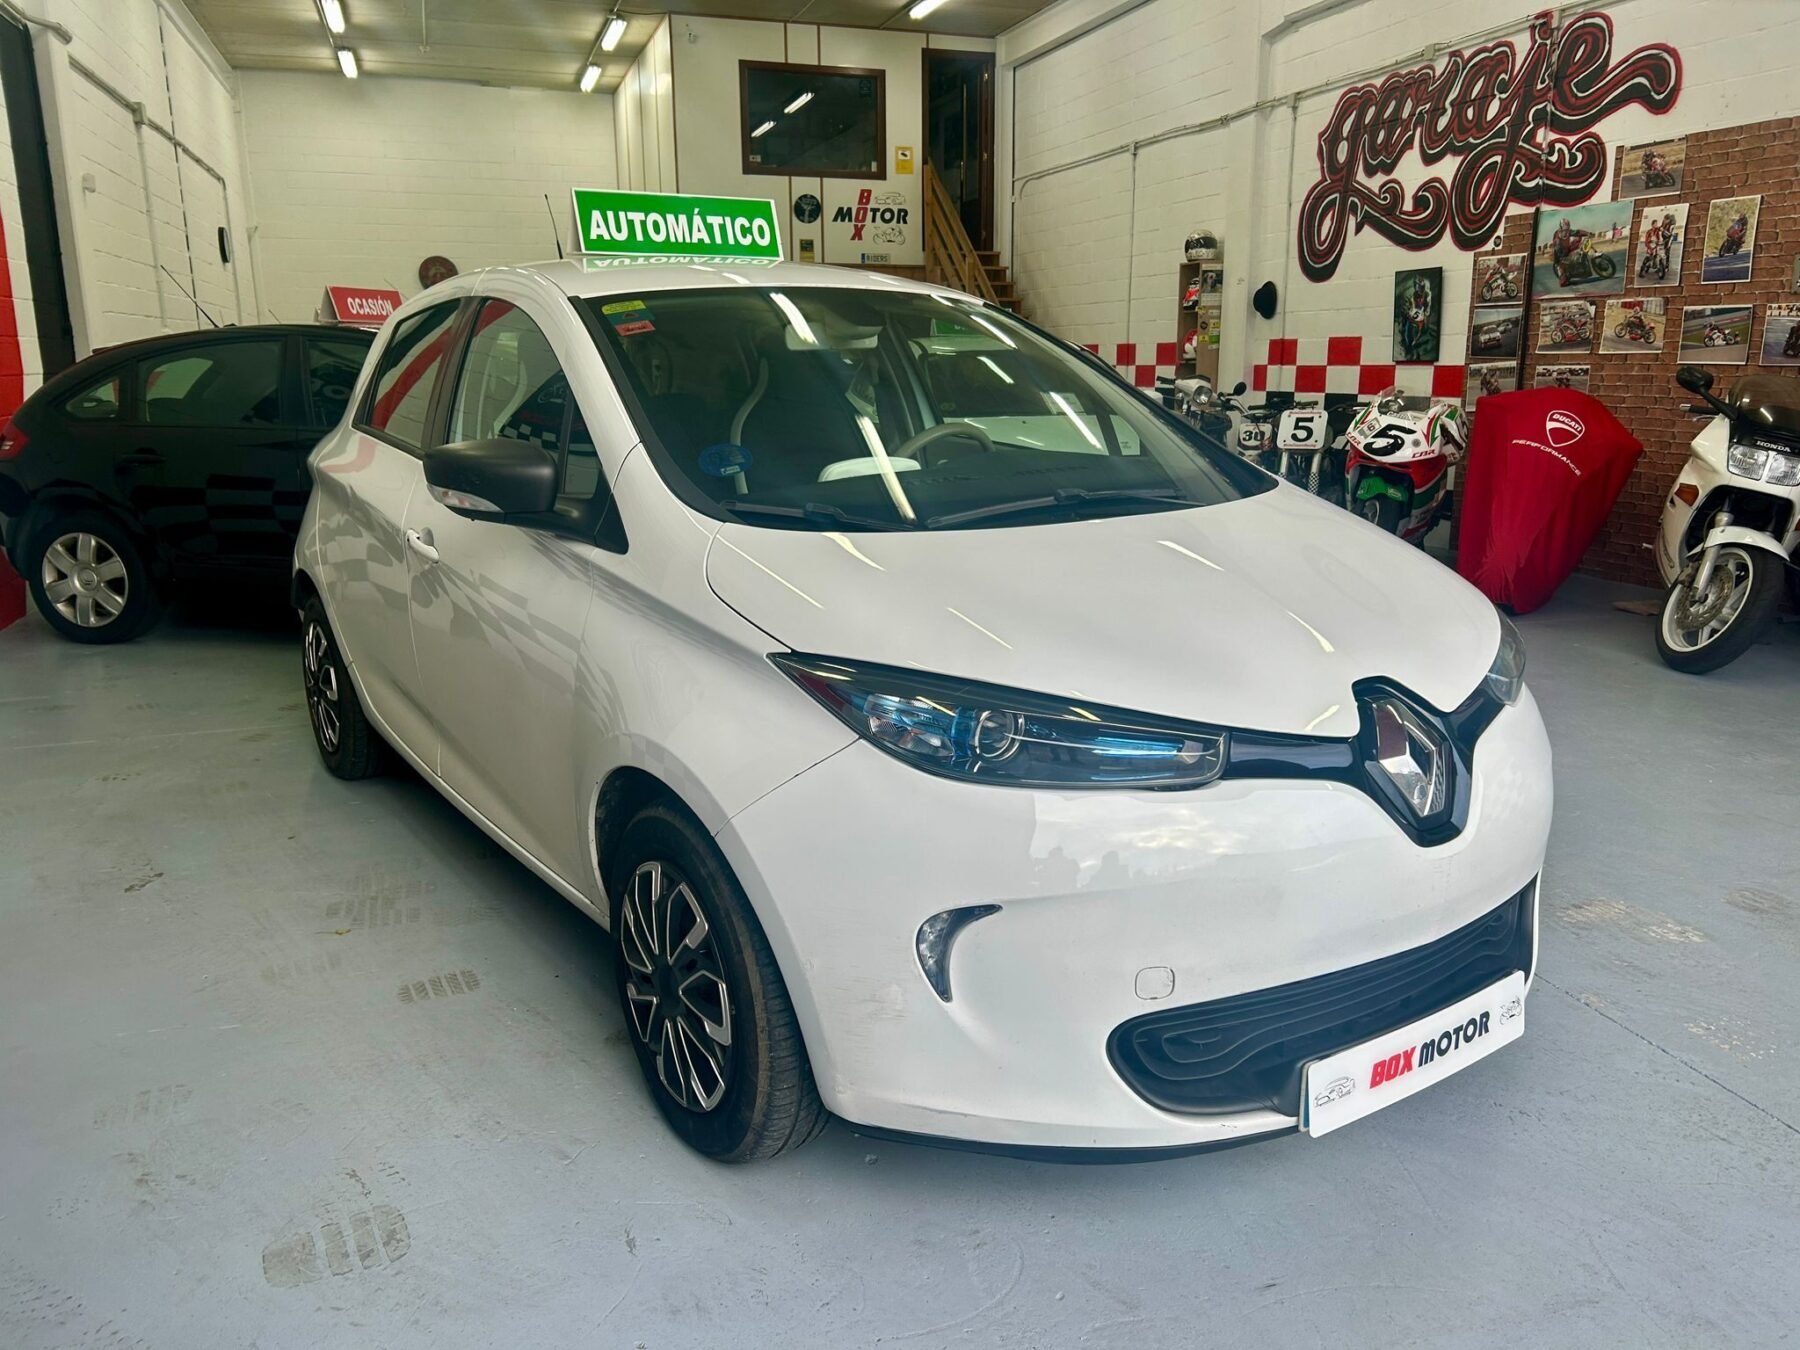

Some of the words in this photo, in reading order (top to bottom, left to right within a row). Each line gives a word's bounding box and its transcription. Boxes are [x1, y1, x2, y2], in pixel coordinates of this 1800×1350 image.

[1298, 11, 1682, 283] garaje
[590, 208, 771, 247] AUTOMÁTICO
[832, 207, 909, 224] MOTOR
[850, 189, 872, 240] BOX
[347, 296, 394, 316] OCASIÓN
[1242, 430, 1266, 442] 30
[1291, 416, 1315, 442] 5
[1552, 413, 1582, 432] DUCATI
[1363, 424, 1417, 456] 5
[1756, 440, 1792, 452] HONDA
[1512, 439, 1582, 476] PERFORMANCE
[1369, 1046, 1417, 1089] BOX
[1418, 1010, 1490, 1068] MOTOR
